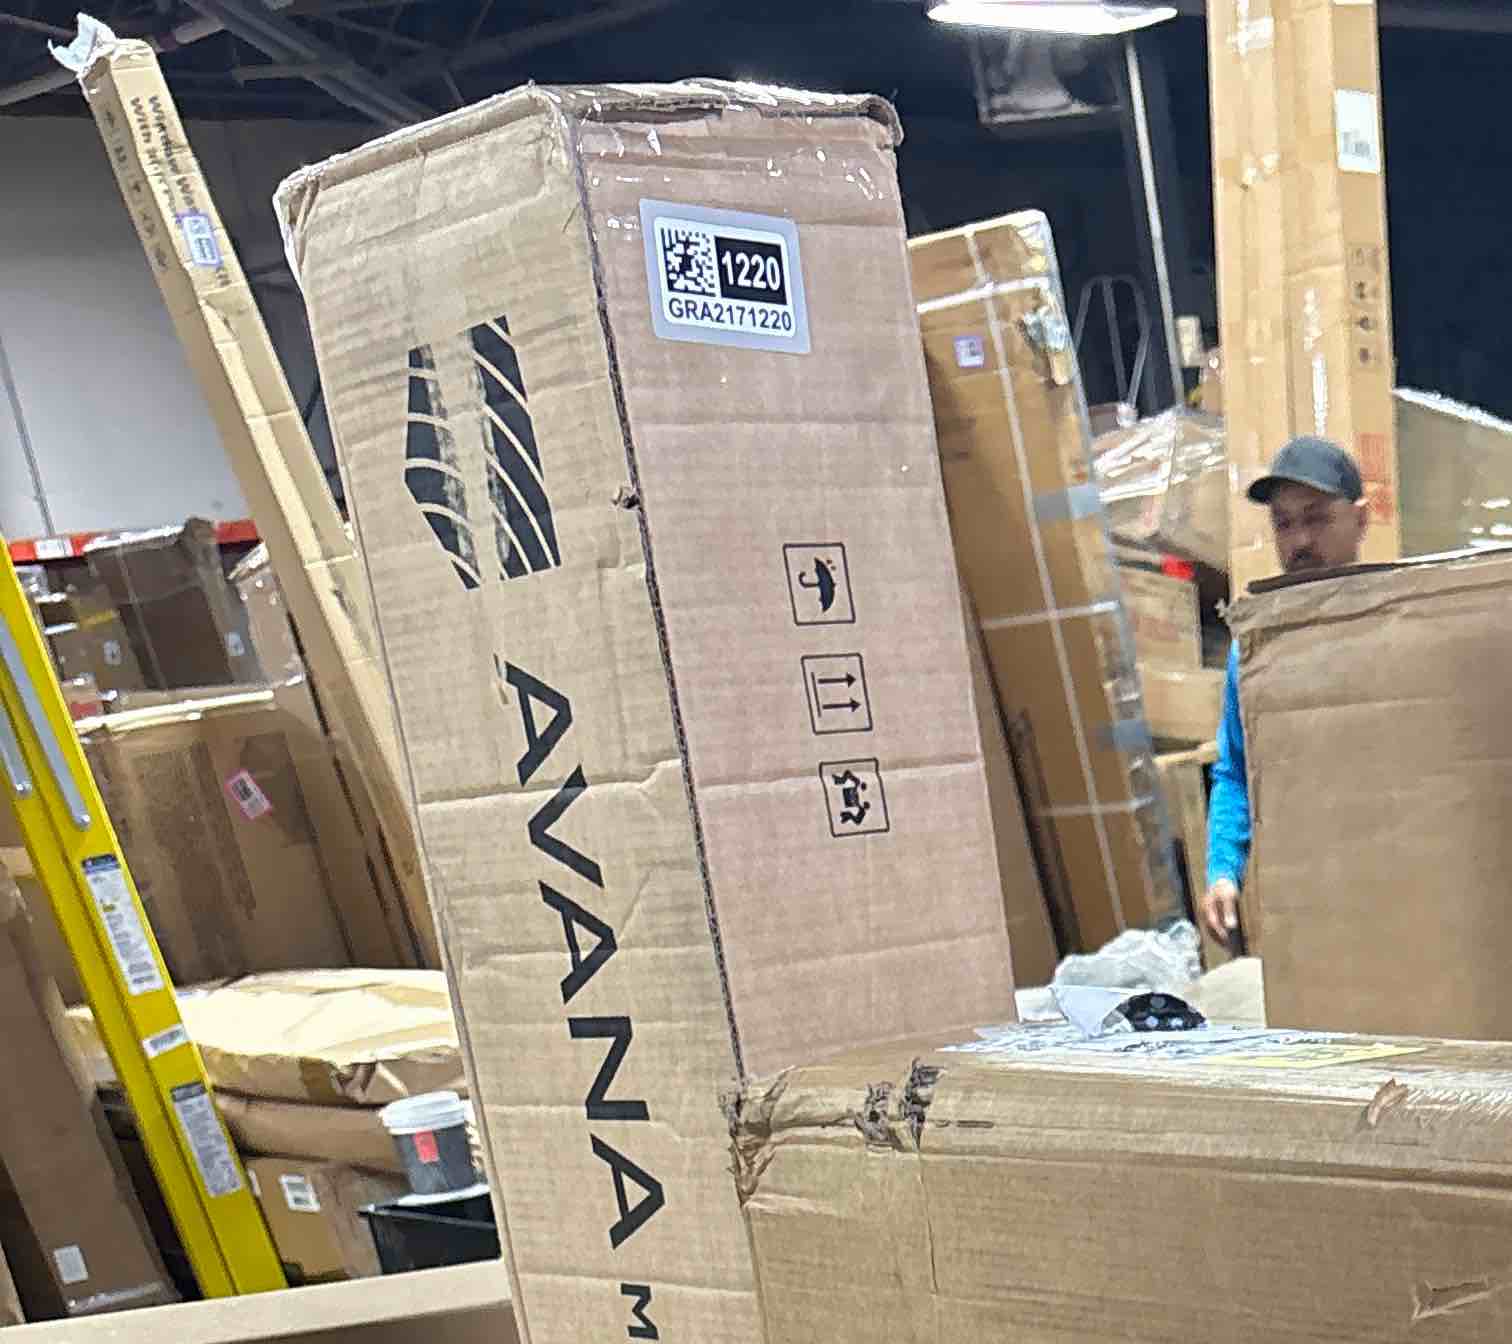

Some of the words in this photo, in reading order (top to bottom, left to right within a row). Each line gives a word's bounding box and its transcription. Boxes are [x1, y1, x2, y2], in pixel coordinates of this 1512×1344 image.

[721, 250, 781, 291] 1220
[668, 297, 792, 332] GRA2171220
[503, 660, 665, 1250] AVANA
